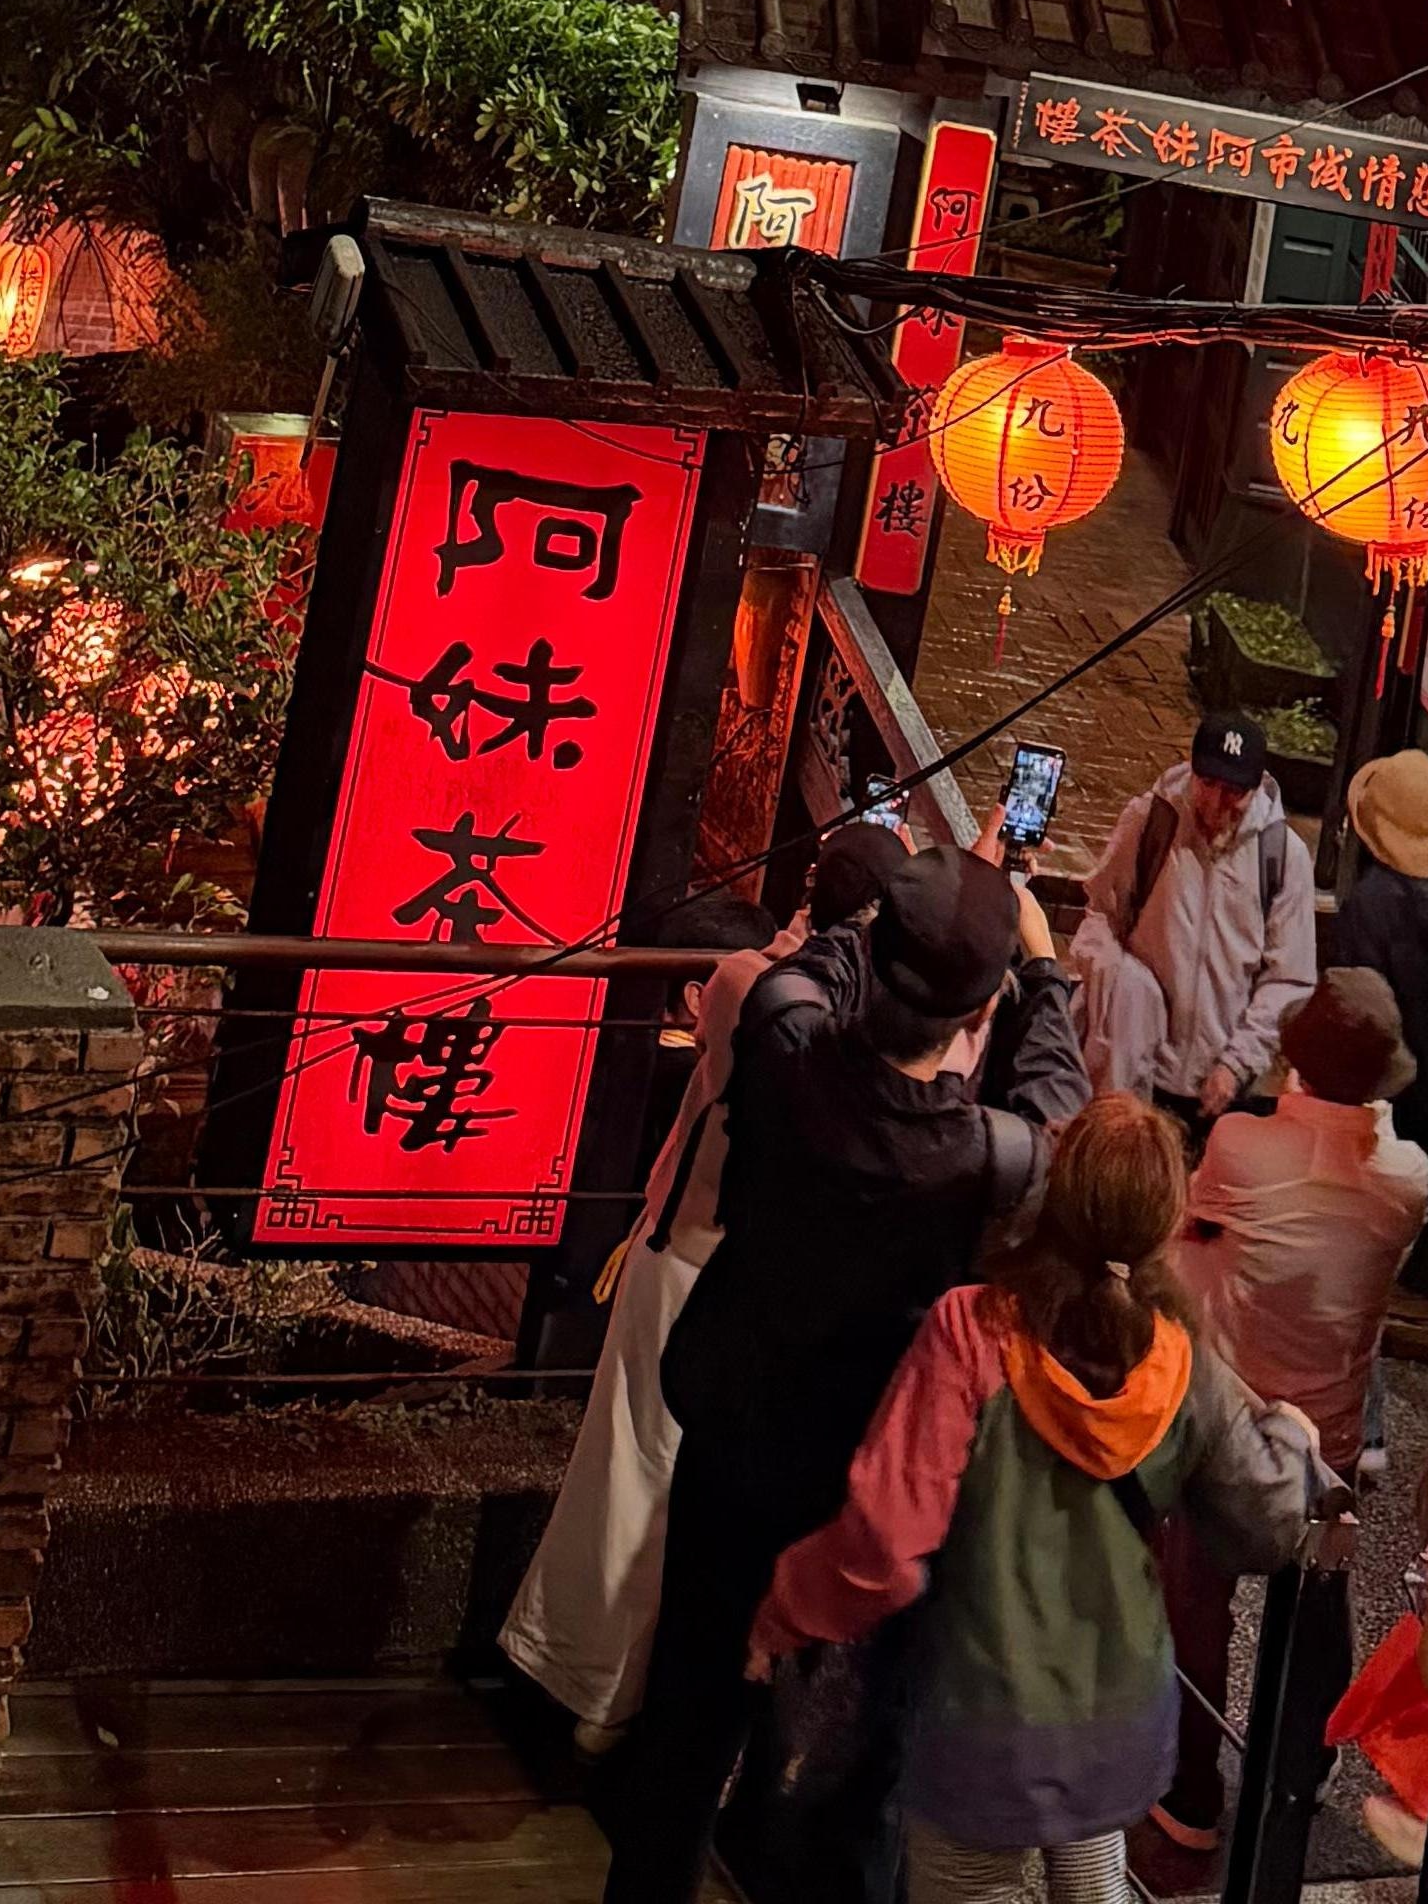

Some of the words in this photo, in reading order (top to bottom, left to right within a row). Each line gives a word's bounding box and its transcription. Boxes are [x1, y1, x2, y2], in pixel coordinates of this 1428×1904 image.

[1008, 396, 1067, 511] 九份
[352, 458, 644, 1152] 阿妹茶樓
